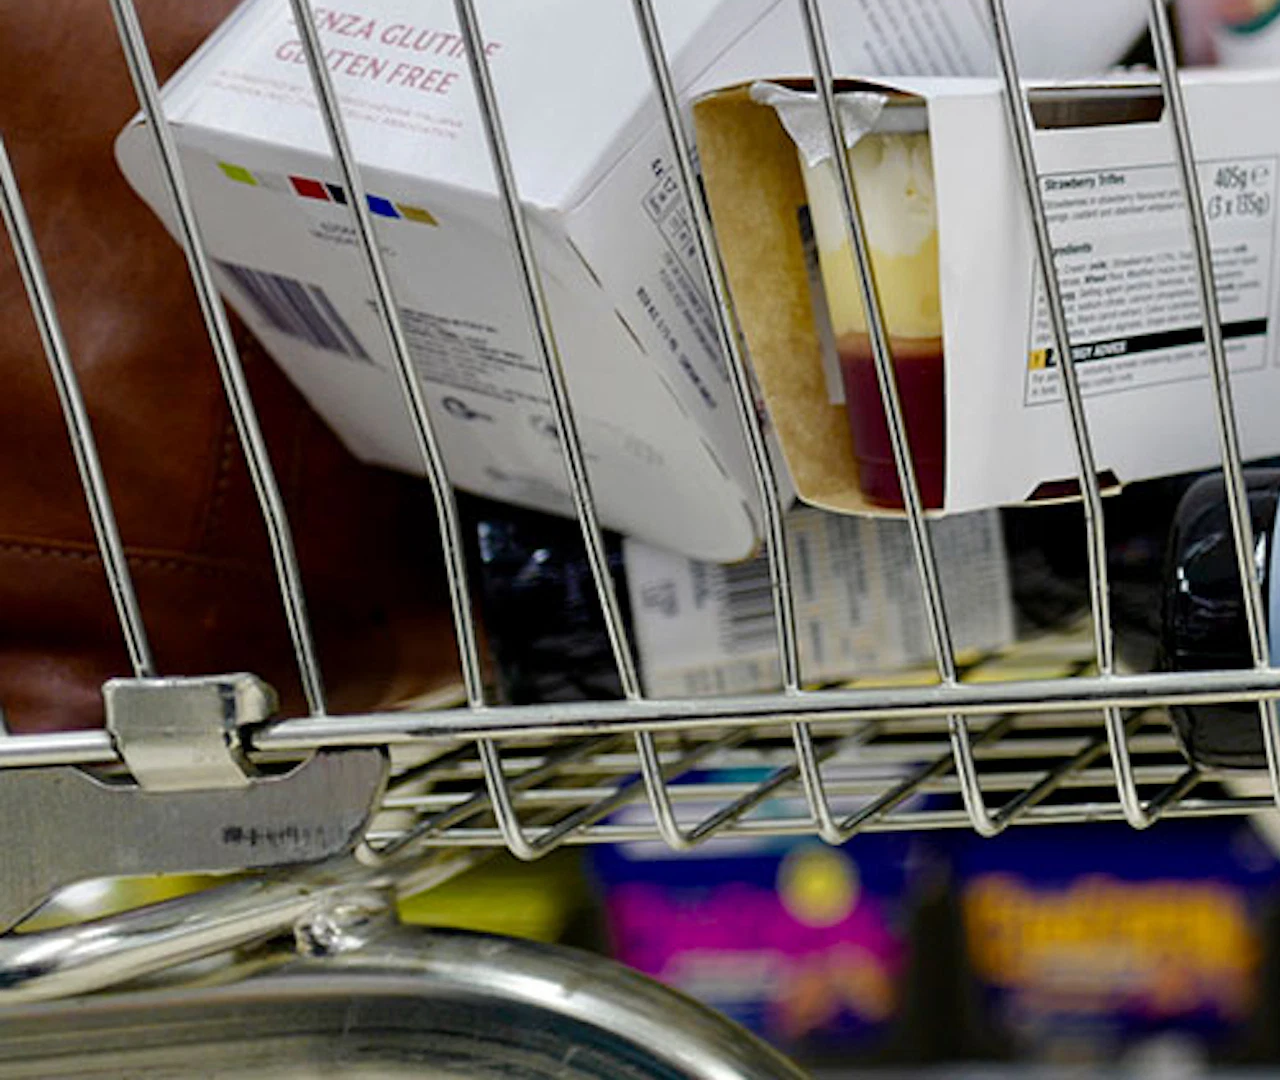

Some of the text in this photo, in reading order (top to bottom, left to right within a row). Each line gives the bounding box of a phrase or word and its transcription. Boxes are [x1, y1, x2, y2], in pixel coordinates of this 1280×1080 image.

[294, 7, 502, 58] NZA GLUTIE
[386, 63, 458, 95] FREE
